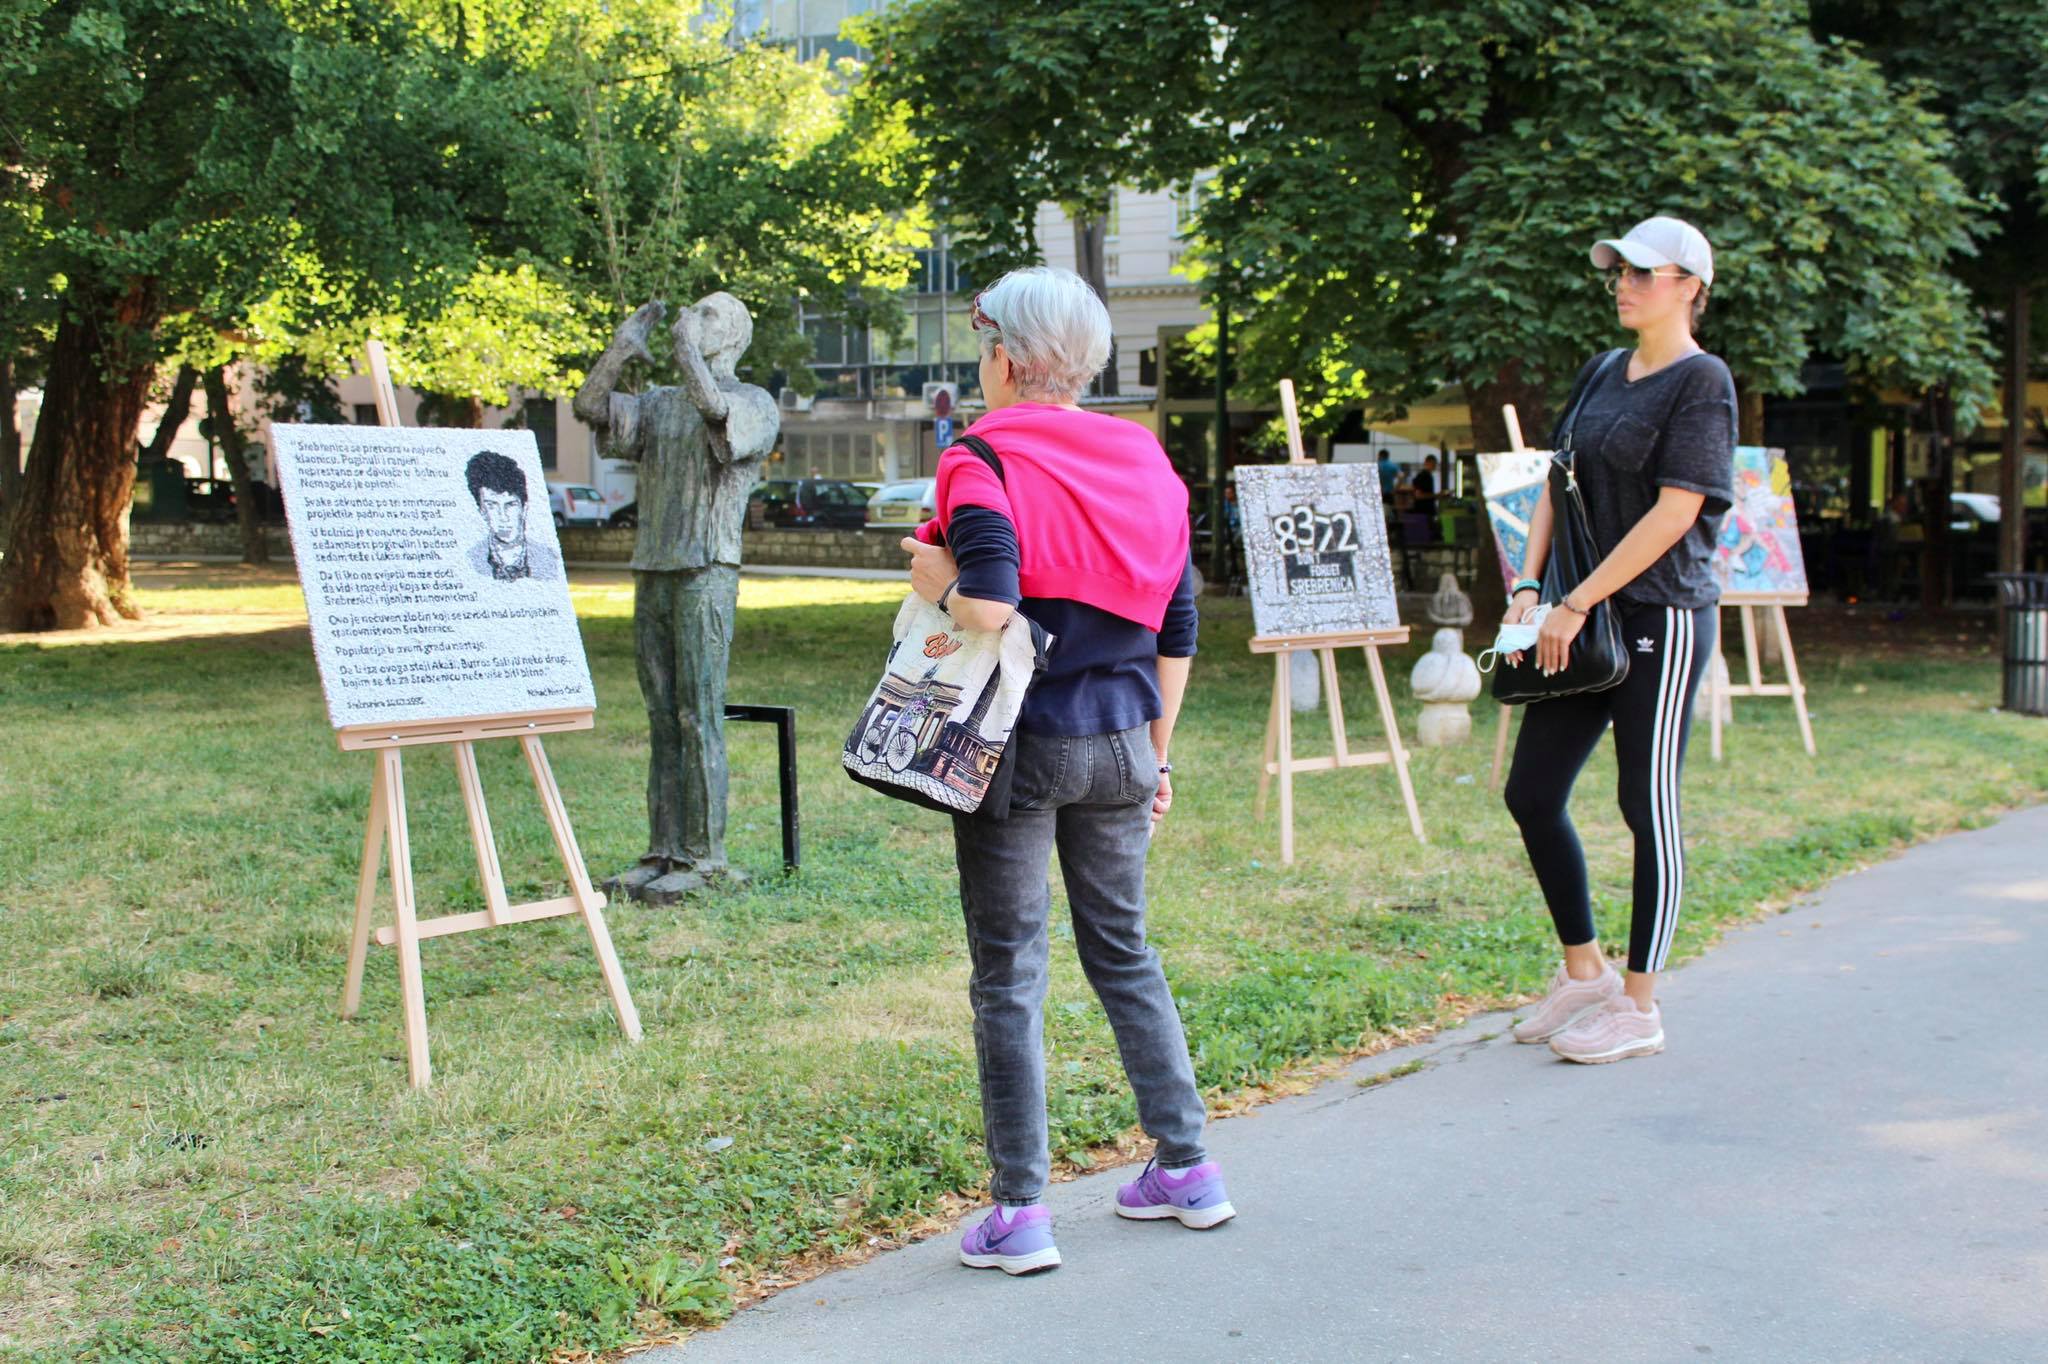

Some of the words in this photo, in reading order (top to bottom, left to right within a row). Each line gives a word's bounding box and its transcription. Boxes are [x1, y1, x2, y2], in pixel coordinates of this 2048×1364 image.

[938, 420, 949, 441] P
[1274, 505, 1358, 554] 8372
[1309, 563, 1341, 577] FORGET
